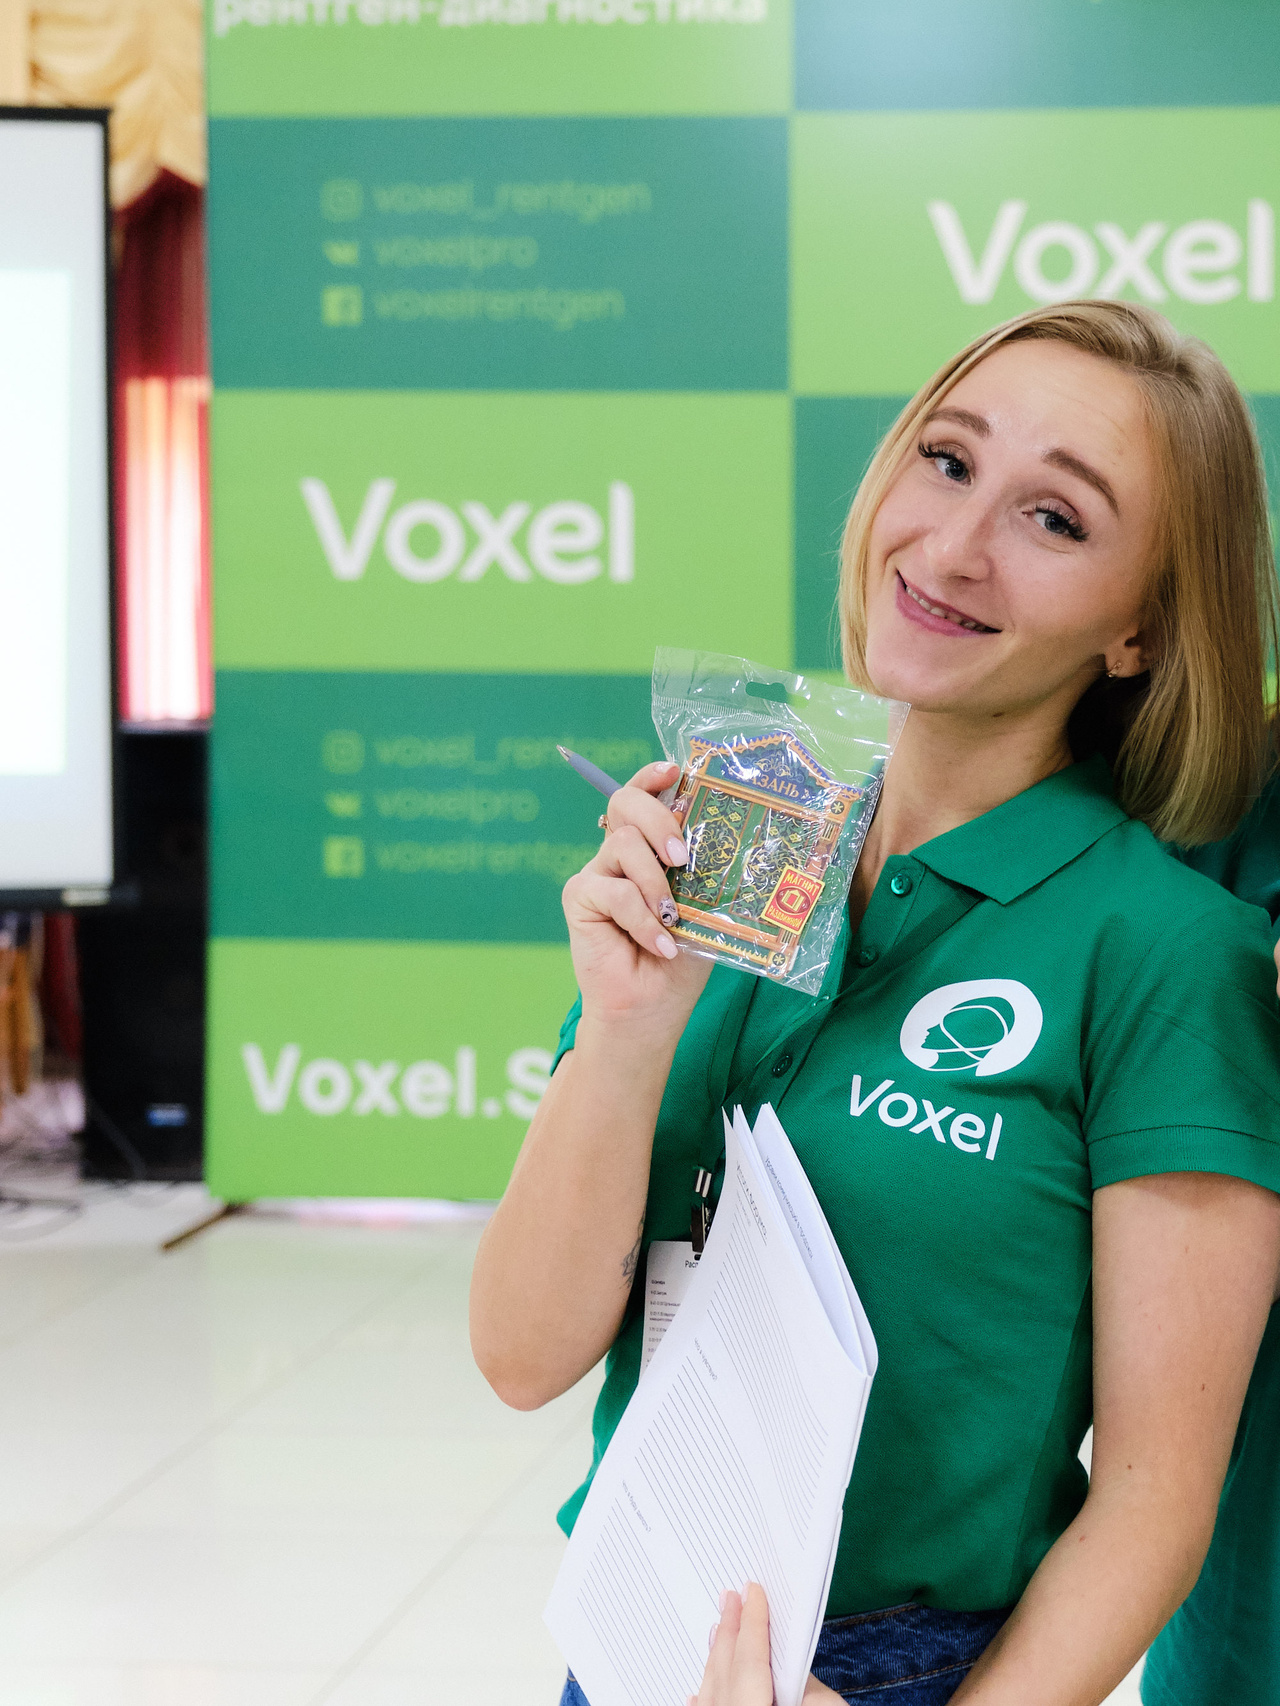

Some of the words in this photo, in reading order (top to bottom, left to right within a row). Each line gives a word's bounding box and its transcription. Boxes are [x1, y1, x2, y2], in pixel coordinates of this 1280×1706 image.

[926, 198, 1275, 304] Voxel
[301, 477, 636, 584] Voxel
[783, 872, 819, 896] МАГНИТ
[850, 1074, 1002, 1161] Voxel
